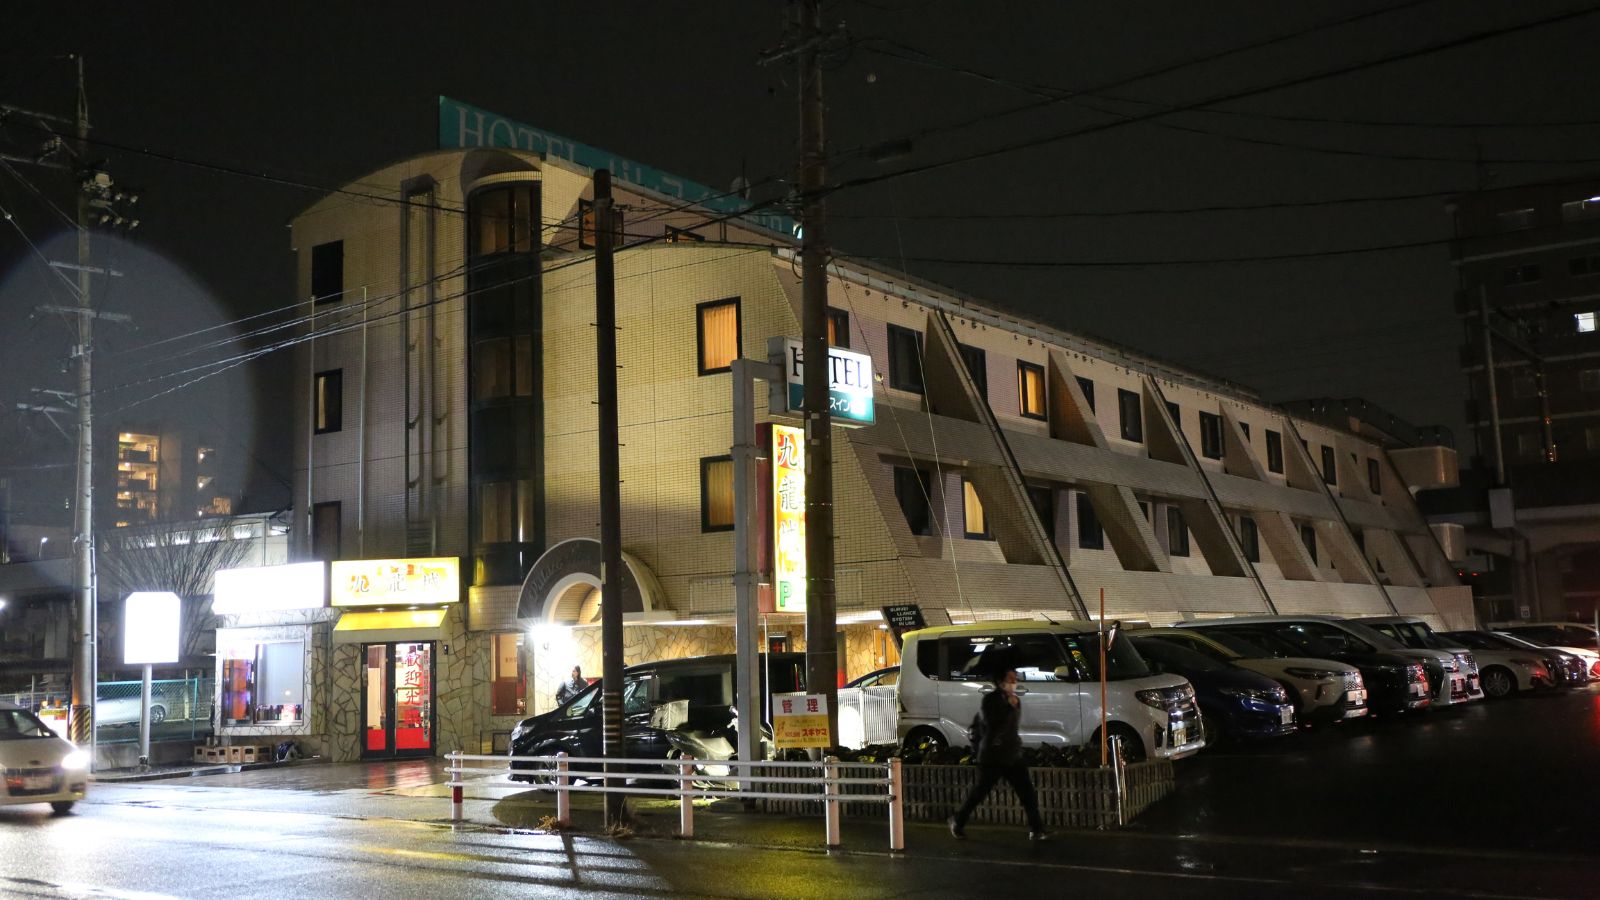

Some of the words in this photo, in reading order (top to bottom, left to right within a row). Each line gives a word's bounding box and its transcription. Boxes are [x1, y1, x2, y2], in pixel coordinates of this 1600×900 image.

[456, 106, 578, 168] HOTEL
[790, 346, 869, 390] HTEL
[779, 580, 792, 607] P
